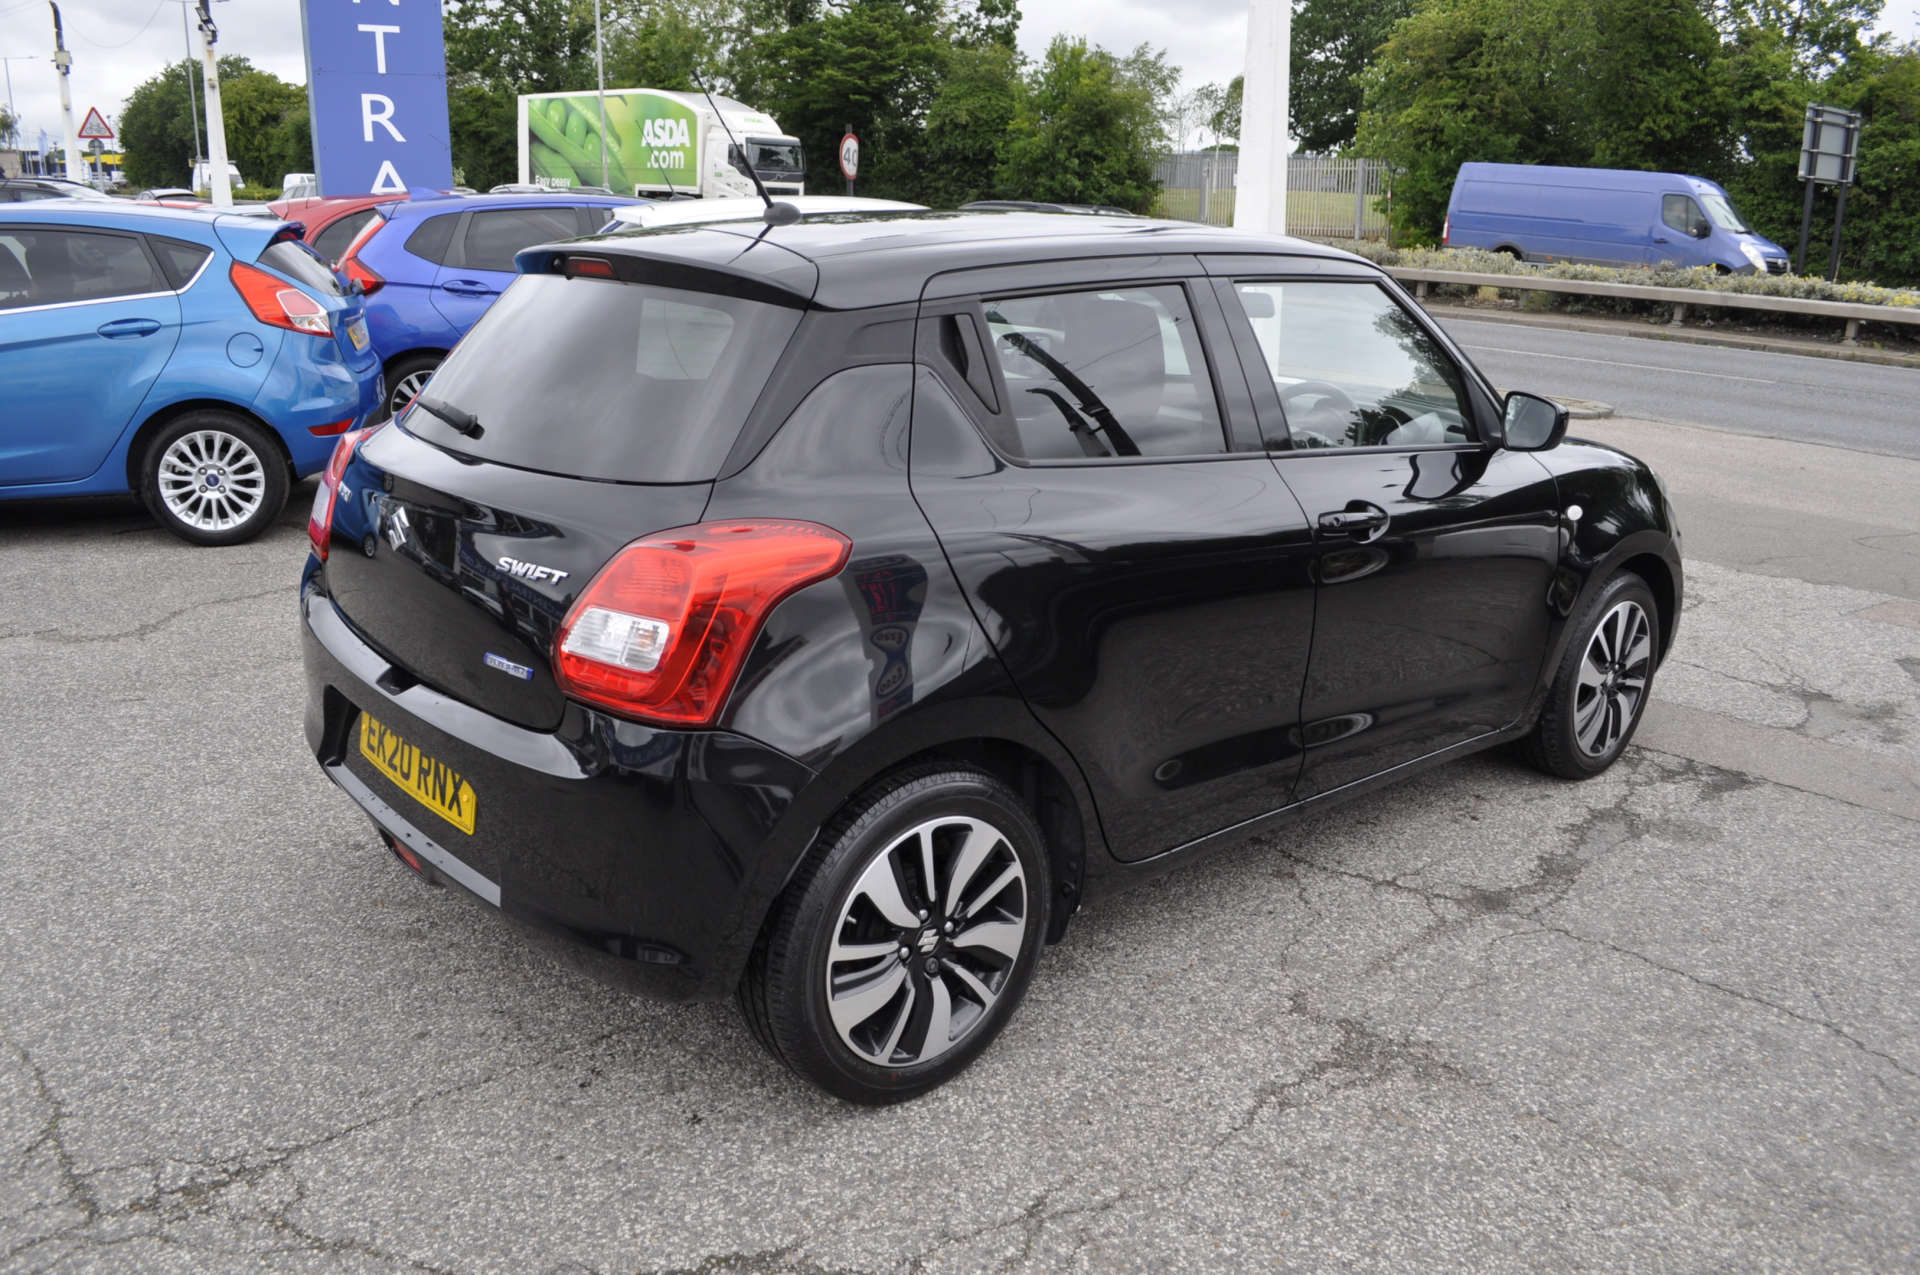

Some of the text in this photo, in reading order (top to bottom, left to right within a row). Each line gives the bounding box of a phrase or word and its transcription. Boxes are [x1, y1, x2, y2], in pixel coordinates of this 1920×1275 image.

[353, 0, 408, 195] TRA
[641, 118, 691, 148] ASDA
[647, 150, 685, 169] .com
[843, 147, 858, 167] 40
[495, 556, 569, 585] SWIFT
[366, 715, 464, 819] EK20 RNX
